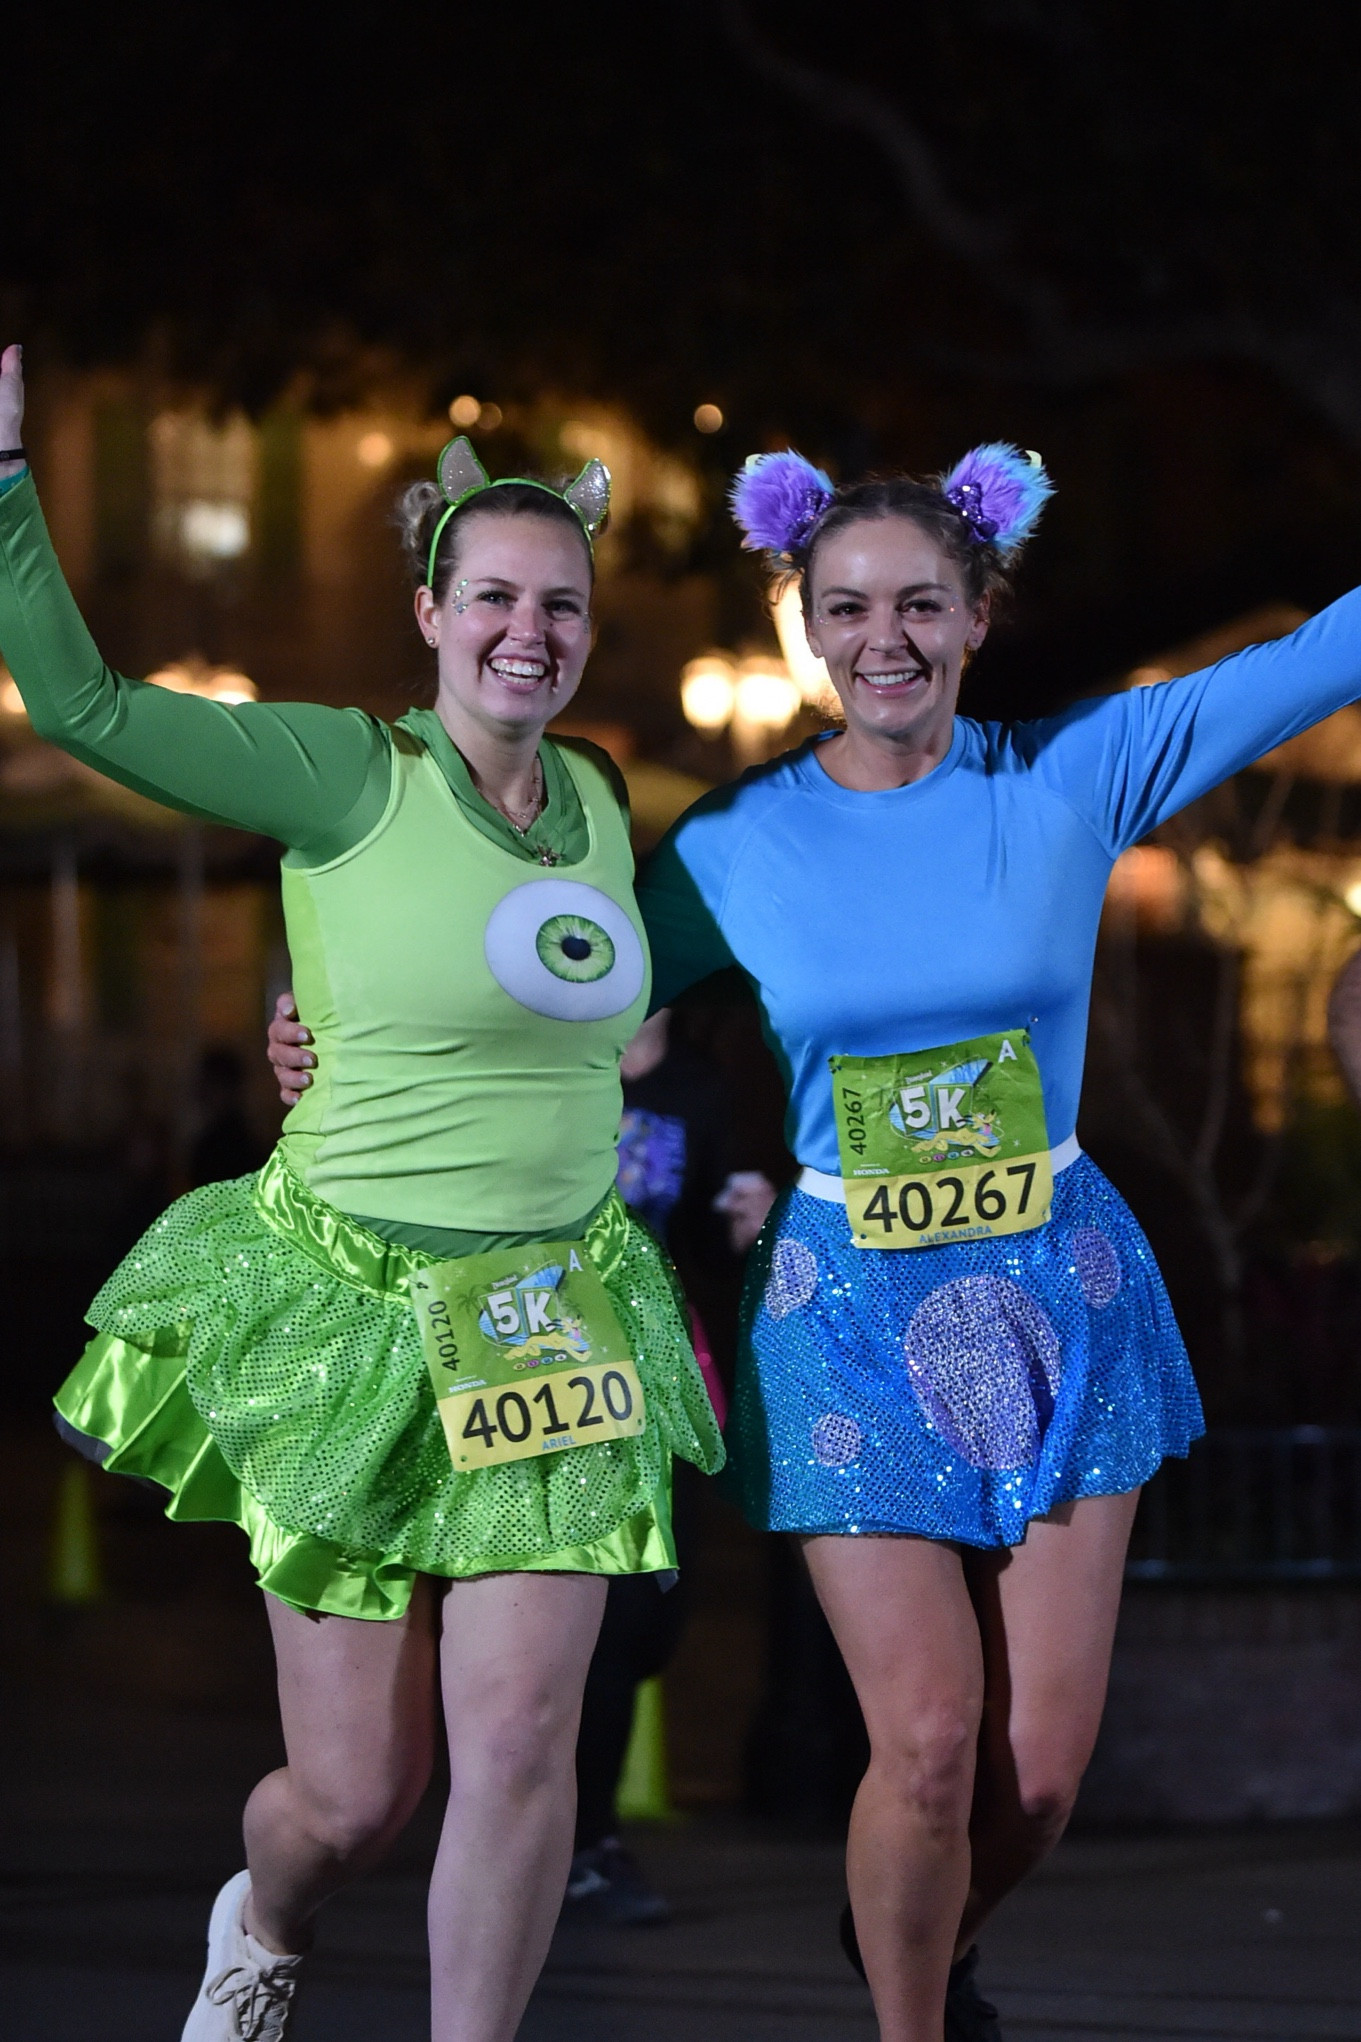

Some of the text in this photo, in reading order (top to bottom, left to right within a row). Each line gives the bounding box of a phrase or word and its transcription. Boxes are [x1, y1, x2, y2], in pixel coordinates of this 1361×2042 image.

[998, 1039, 1018, 1063] A
[842, 1087, 867, 1156] 40267
[900, 1085, 966, 1129] 5K
[862, 1162, 1037, 1233] 40267
[919, 1225, 993, 1244] ALEXANDRA
[569, 1249, 584, 1272] A
[487, 1291, 557, 1334] 5K
[427, 1300, 461, 1371] 40120
[462, 1370, 633, 1449] 40120
[541, 1435, 577, 1451] ARIEL
